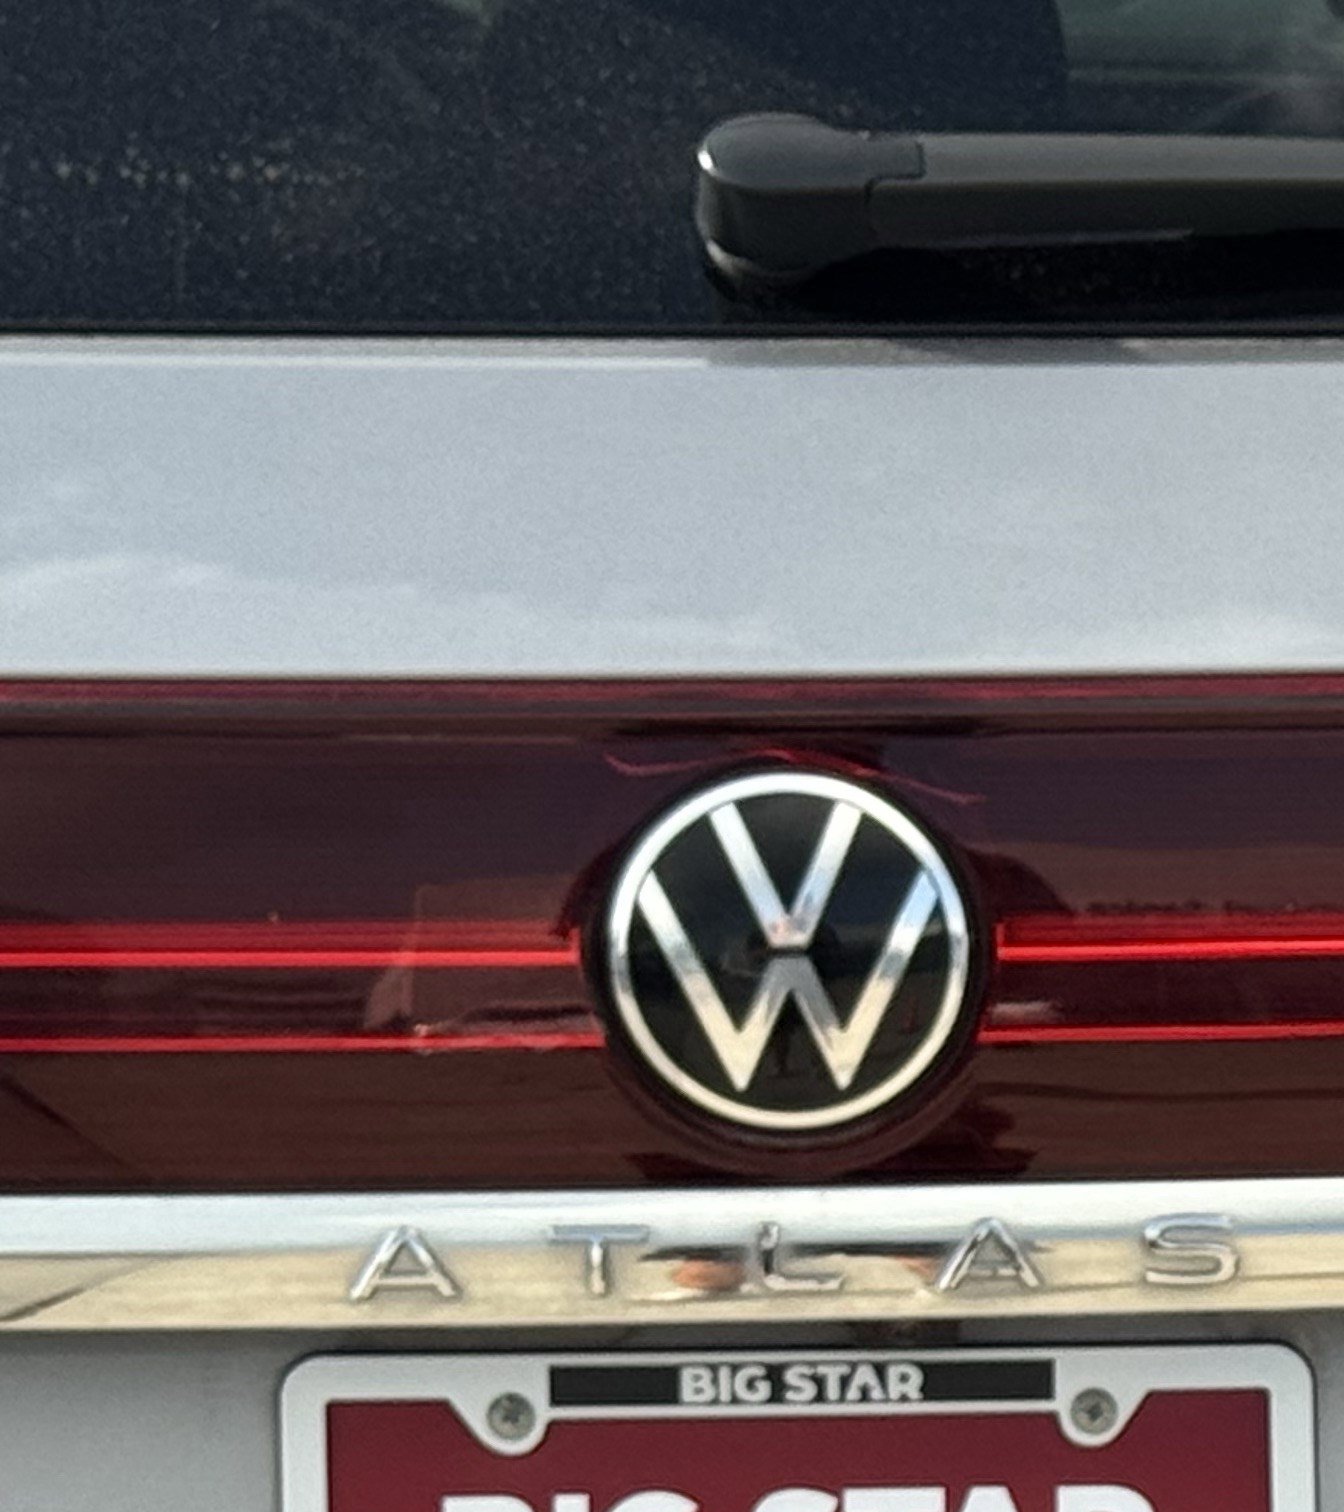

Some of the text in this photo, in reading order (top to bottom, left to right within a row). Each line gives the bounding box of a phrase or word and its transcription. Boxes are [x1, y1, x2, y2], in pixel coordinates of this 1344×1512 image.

[635, 798, 942, 1094] VW
[350, 1214, 1240, 1302] ATLAS
[680, 1362, 925, 1403] BIG STAR
